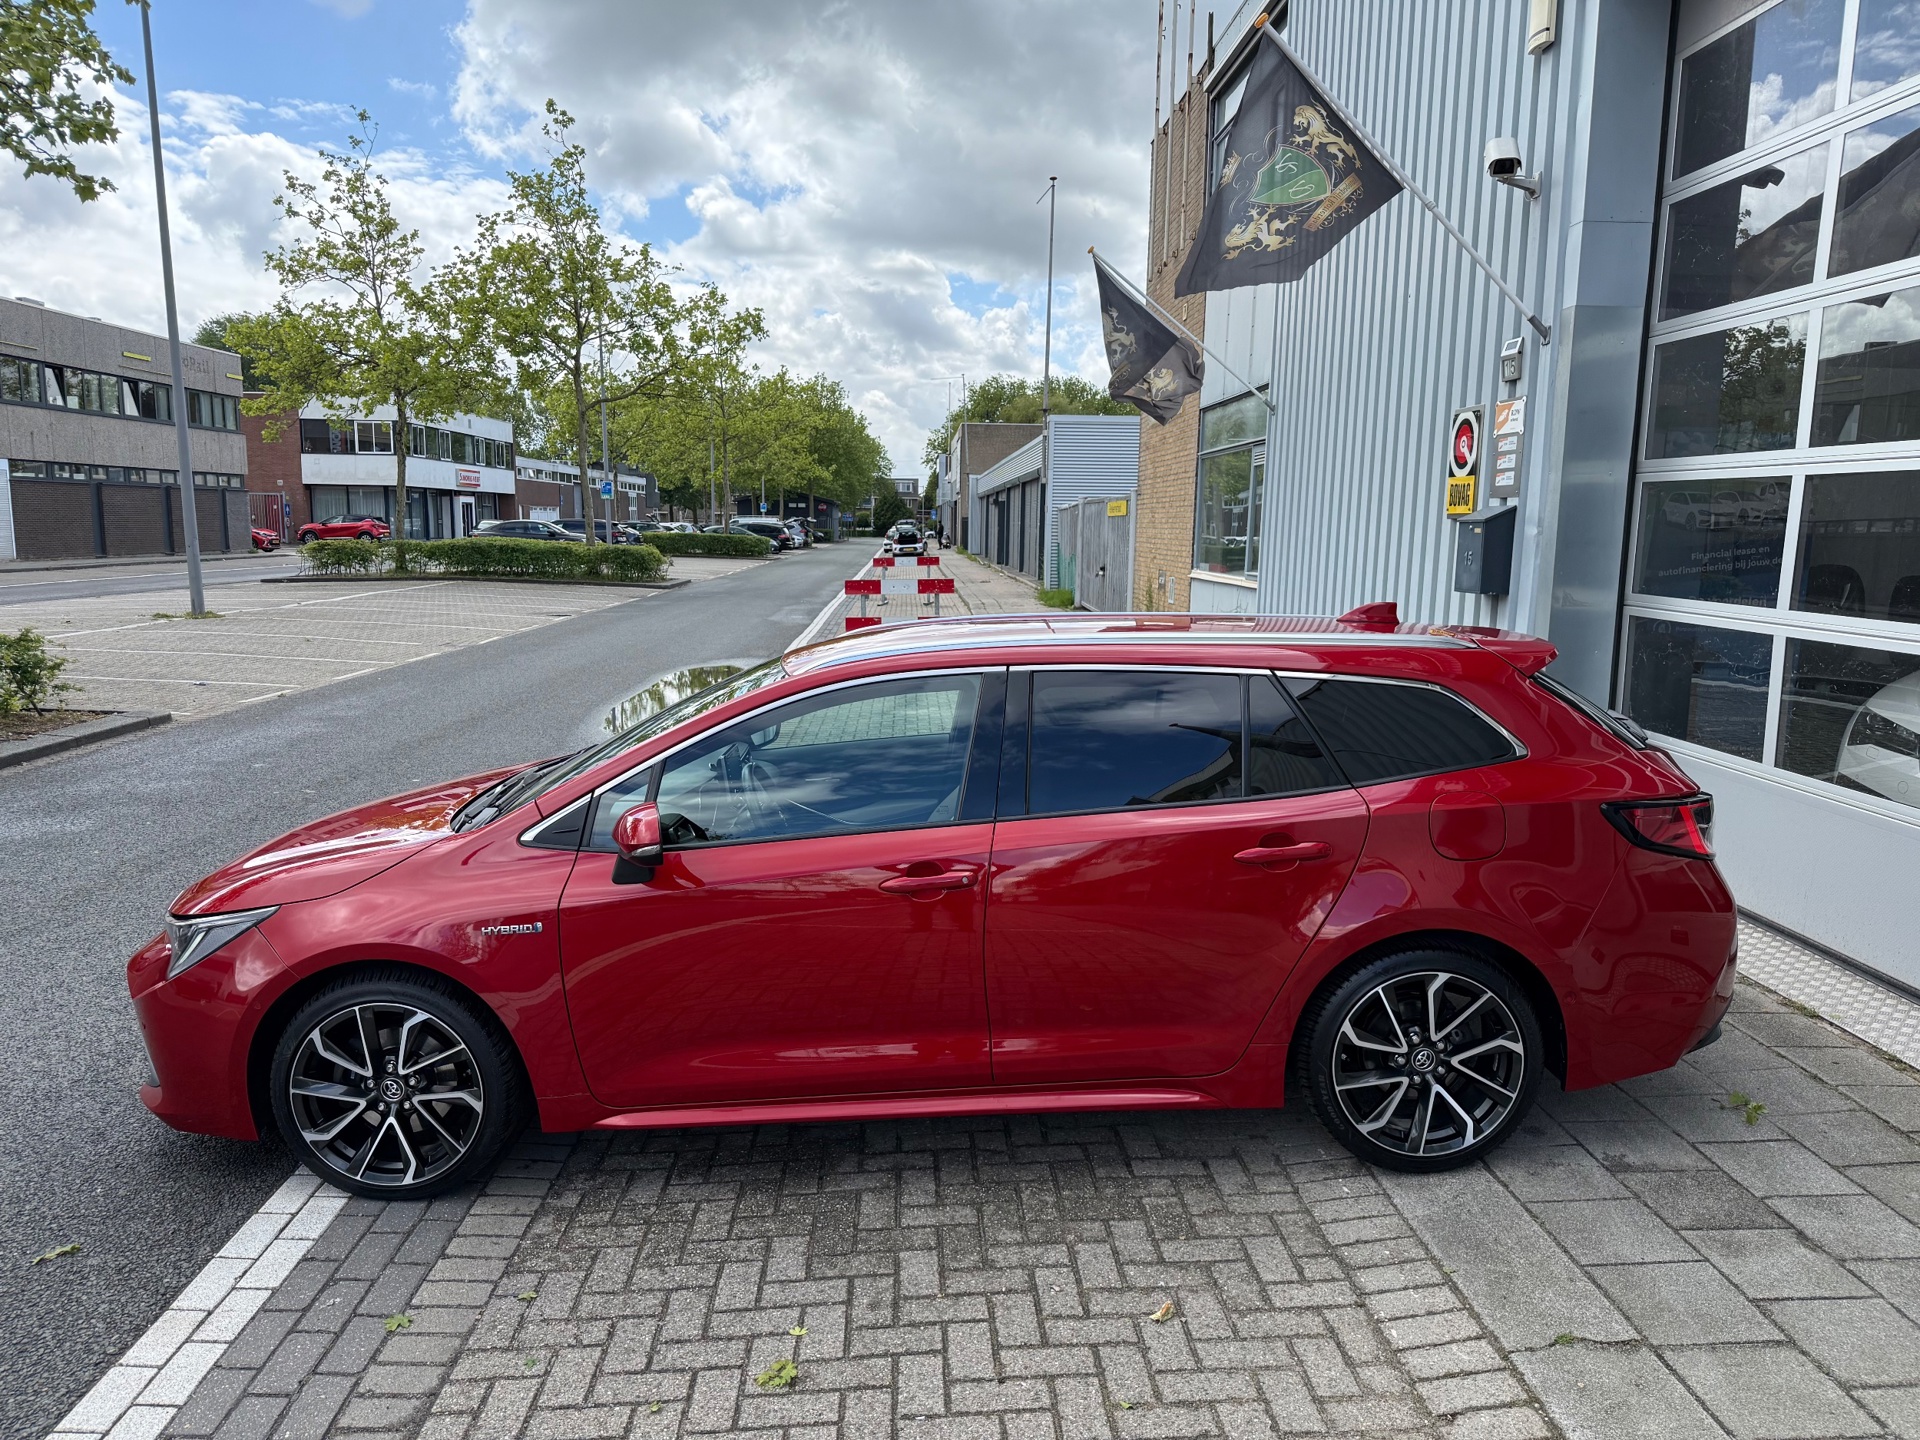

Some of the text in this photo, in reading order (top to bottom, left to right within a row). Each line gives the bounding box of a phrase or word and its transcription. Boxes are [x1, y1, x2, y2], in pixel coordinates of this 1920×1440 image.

[1505, 359, 1516, 376] 15
[1449, 482, 1471, 507] BOVAG
[1464, 551, 1474, 566] 15
[1691, 546, 1770, 561] Financial lease en
[1658, 562, 1733, 577] autofinanciering
[1735, 559, 1747, 570] bij
[1747, 557, 1770, 569] jouw
[481, 924, 533, 936] HYBRID
